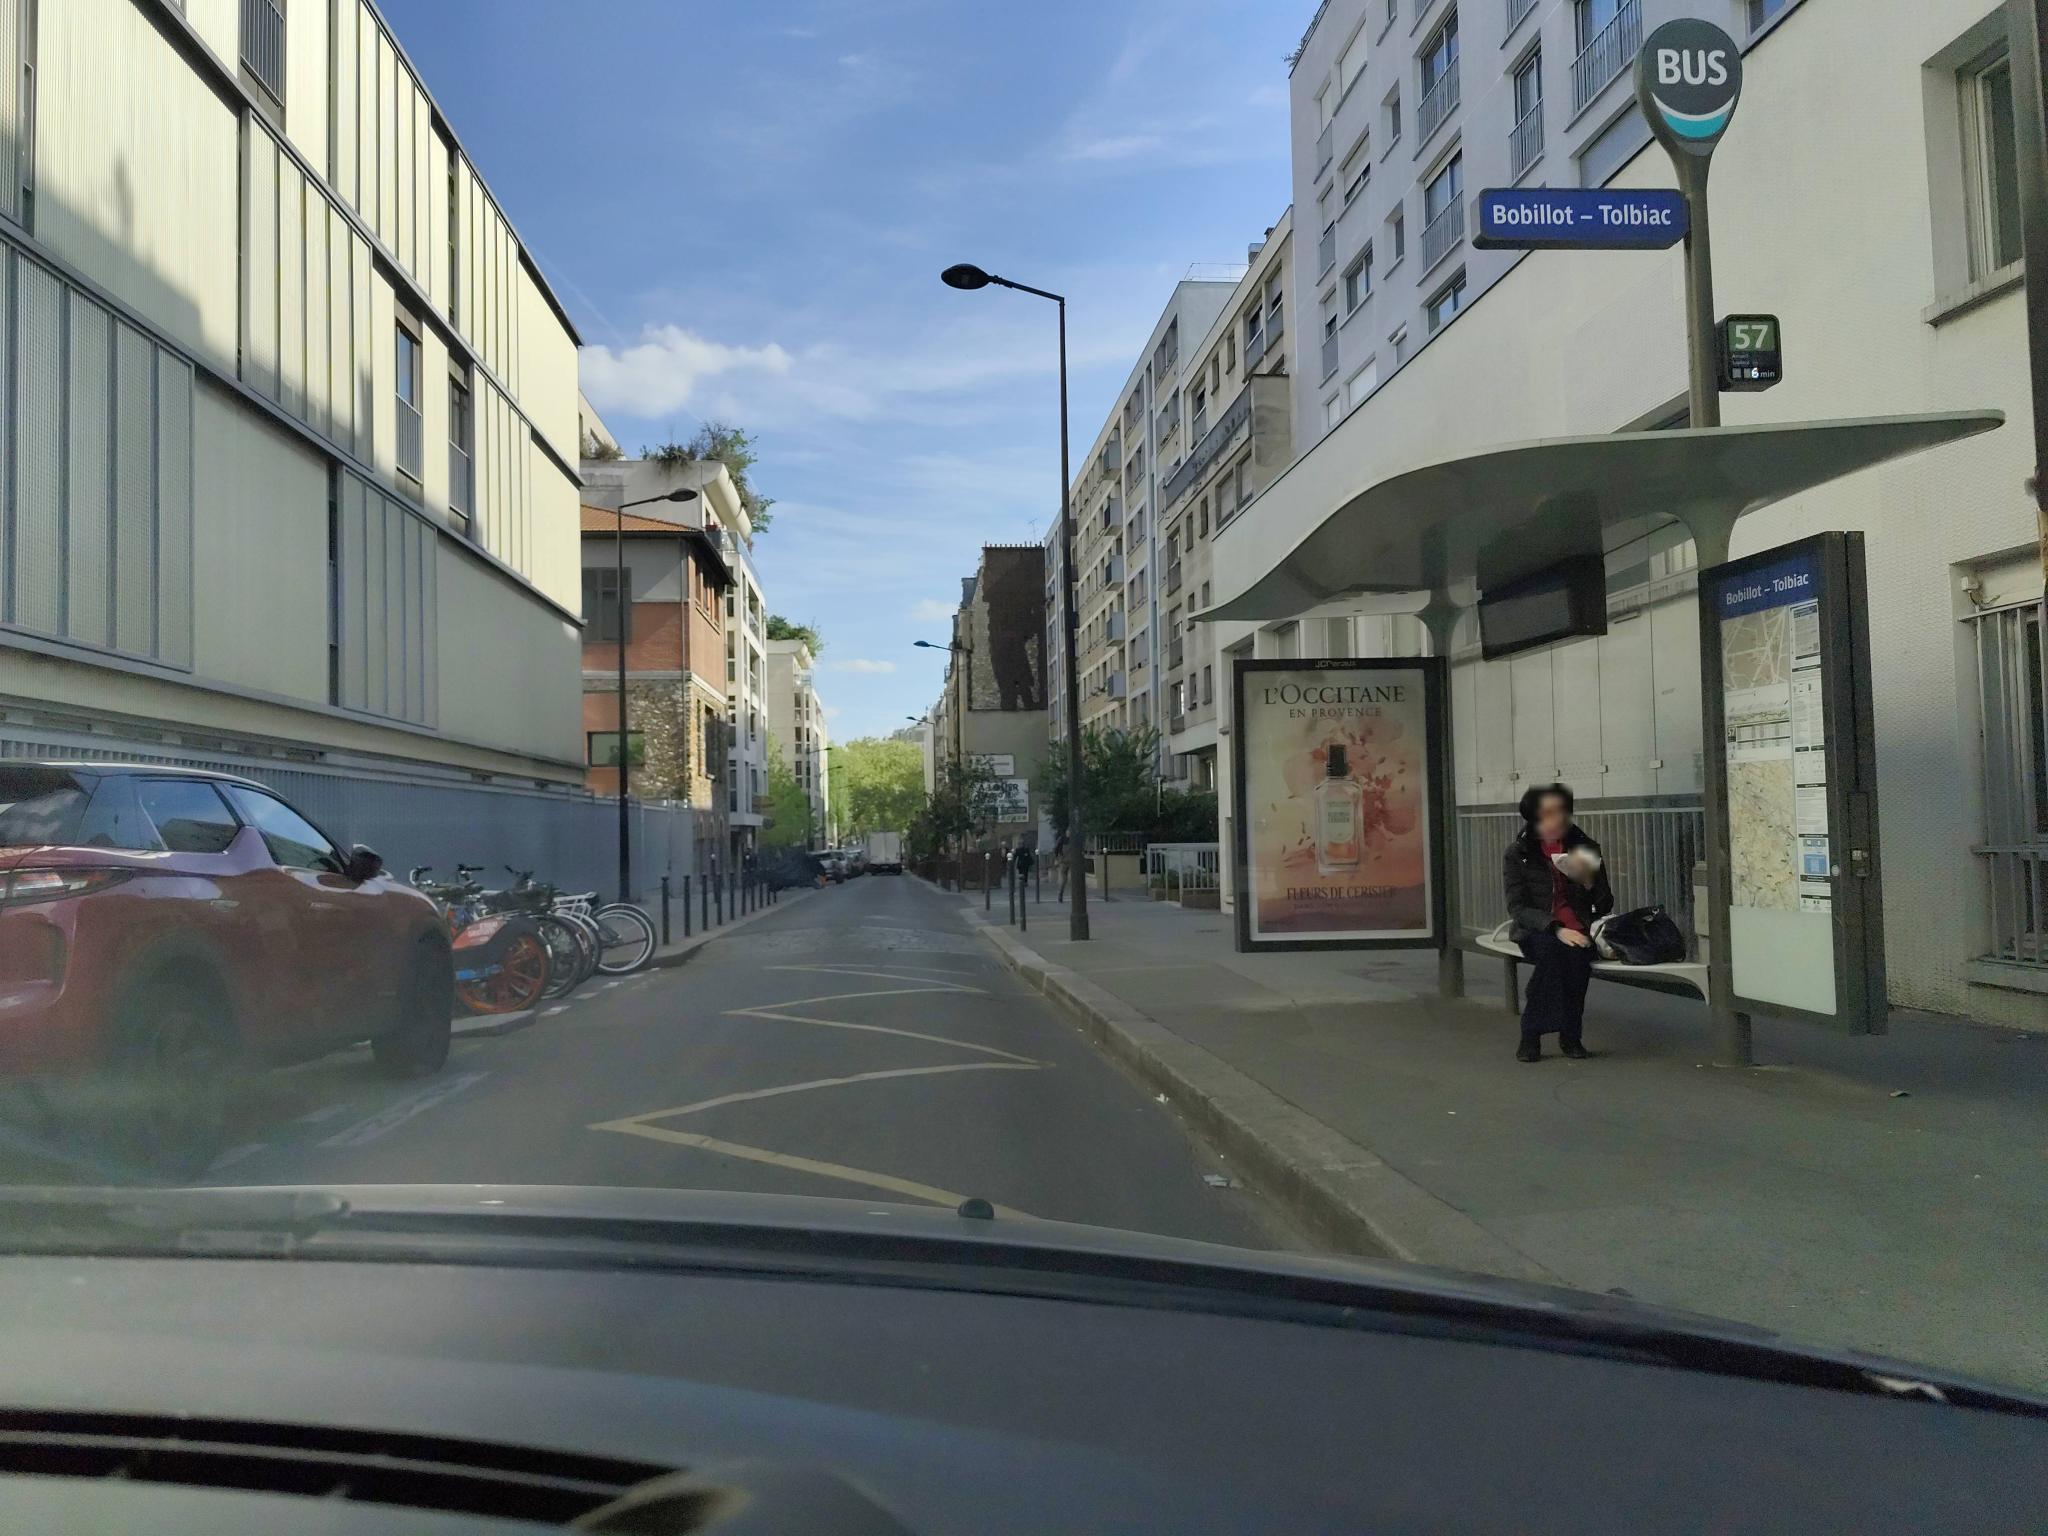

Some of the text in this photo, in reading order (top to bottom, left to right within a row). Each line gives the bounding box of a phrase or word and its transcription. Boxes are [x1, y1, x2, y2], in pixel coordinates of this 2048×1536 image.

[1656, 48, 1728, 87] BUS
[1492, 204, 1574, 225] Bobillot
[1598, 204, 1672, 225] Tolbiac
[1735, 325, 1769, 350] 57
[1751, 367, 1776, 379] 6 min
[1726, 585, 1762, 606] Bobillot
[1772, 573, 1809, 593] Tolbiac
[1263, 684, 1406, 705] L'OCCITANE
[1289, 707, 1382, 718] EN PROVENCE
[1287, 887, 1328, 900] FLEURS
[1329, 886, 1344, 899] DE
